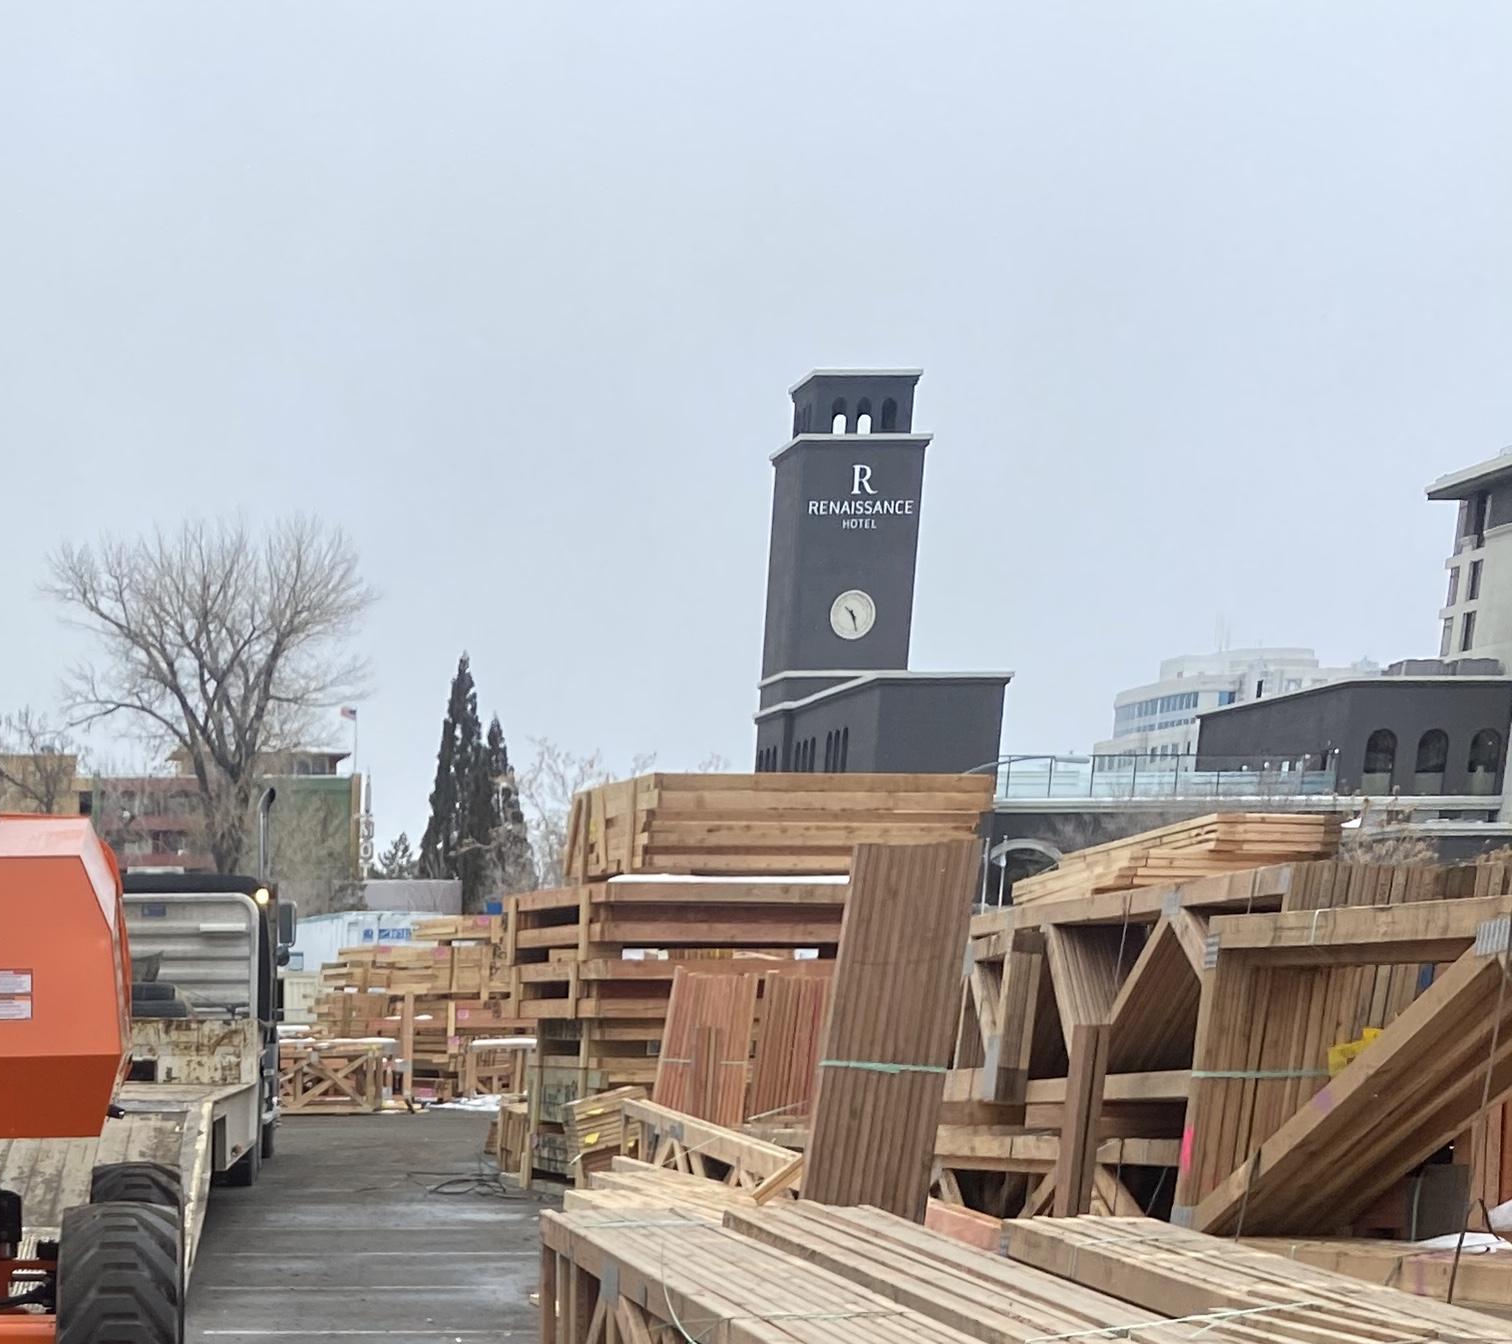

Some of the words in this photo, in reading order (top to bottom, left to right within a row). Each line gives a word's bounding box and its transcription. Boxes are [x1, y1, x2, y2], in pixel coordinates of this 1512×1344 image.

[850, 464, 878, 495] R
[808, 499, 914, 516] RENAISSANCE
[842, 518, 877, 529] HOTEL
